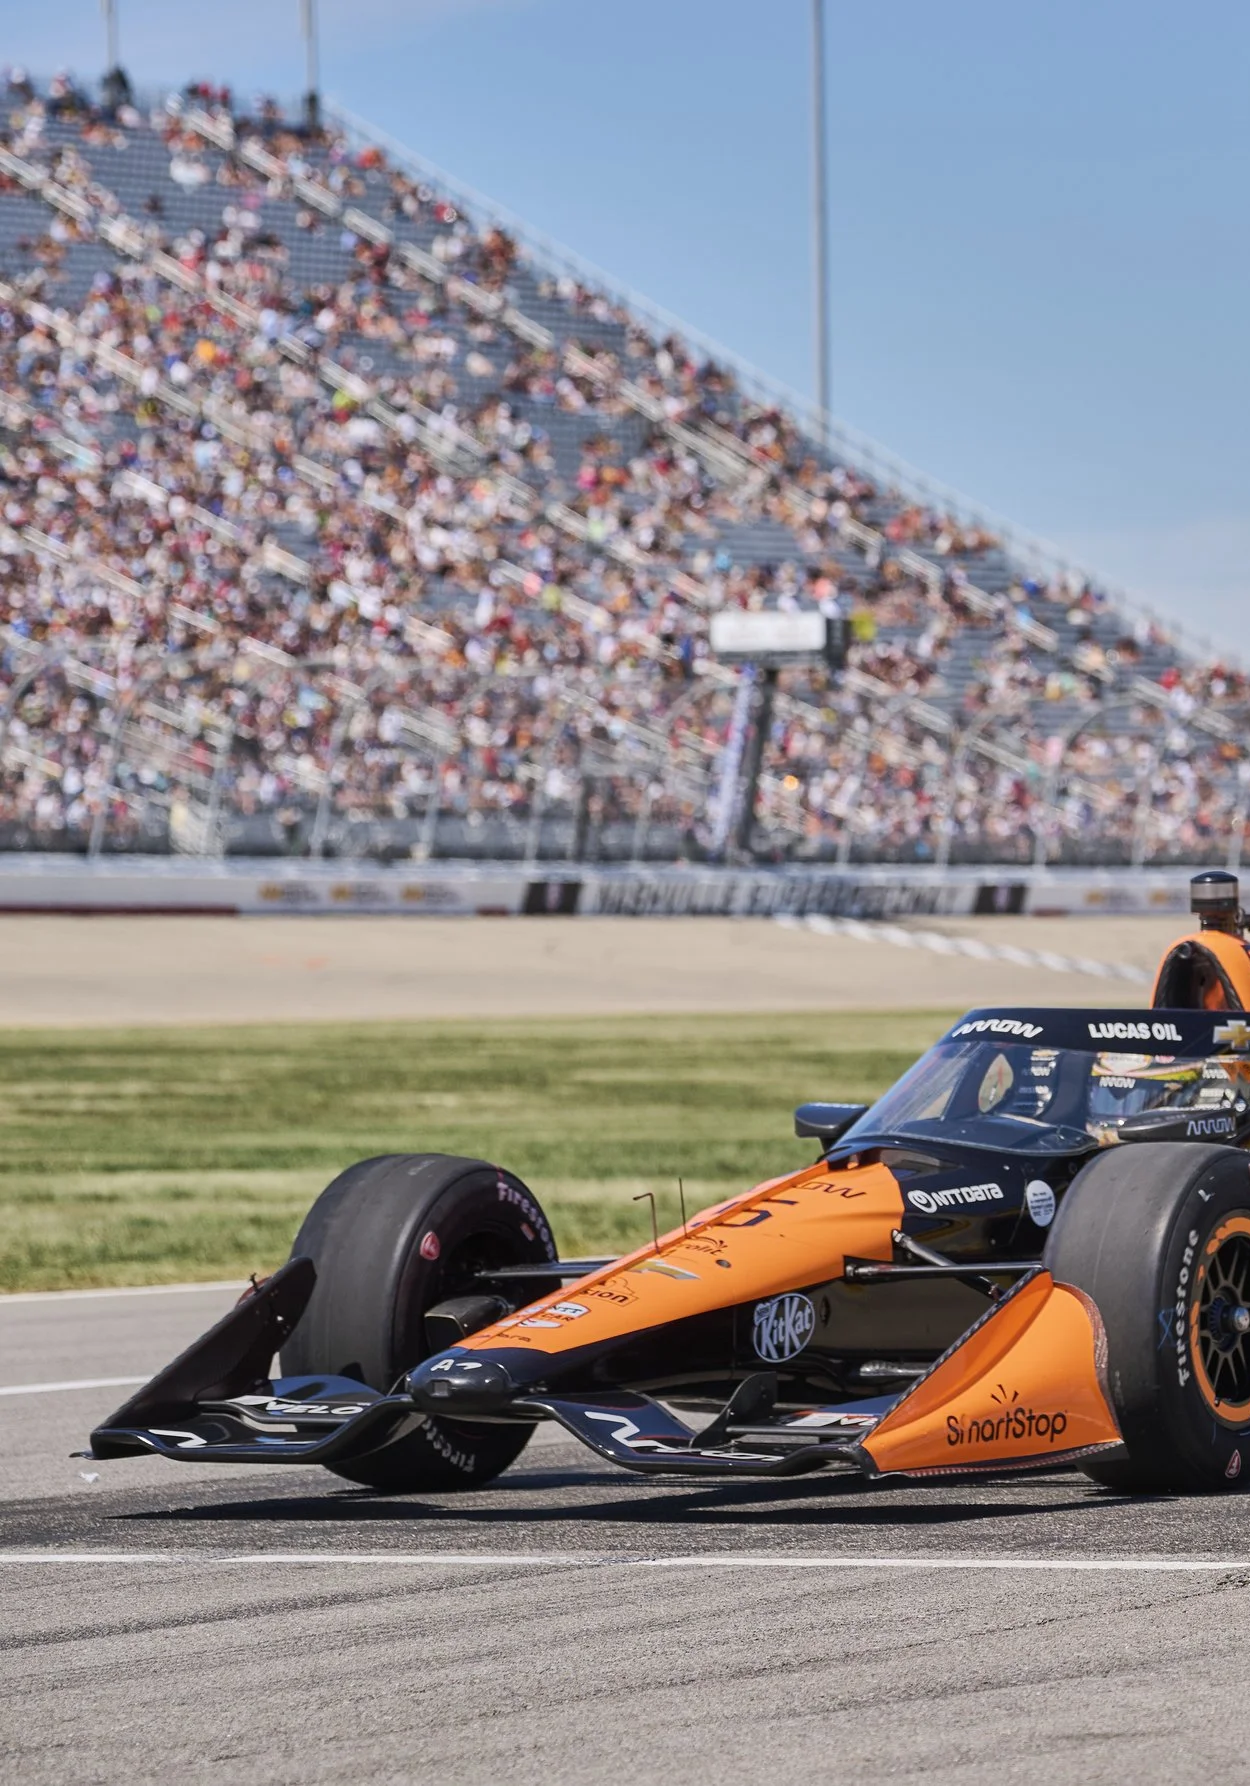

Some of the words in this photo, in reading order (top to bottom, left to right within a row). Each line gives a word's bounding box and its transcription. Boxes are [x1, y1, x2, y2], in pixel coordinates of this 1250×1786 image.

[951, 1018, 1044, 1039] ARROW
[1087, 1022, 1151, 1040] LUCAS
[1151, 1022, 1183, 1041] OIL
[1186, 1116, 1237, 1137] ARROW
[1175, 1228, 1199, 1387] Firestone
[760, 1297, 812, 1360] KitKat
[265, 1401, 364, 1415] VELO
[946, 1407, 1068, 1446] SmartStop
